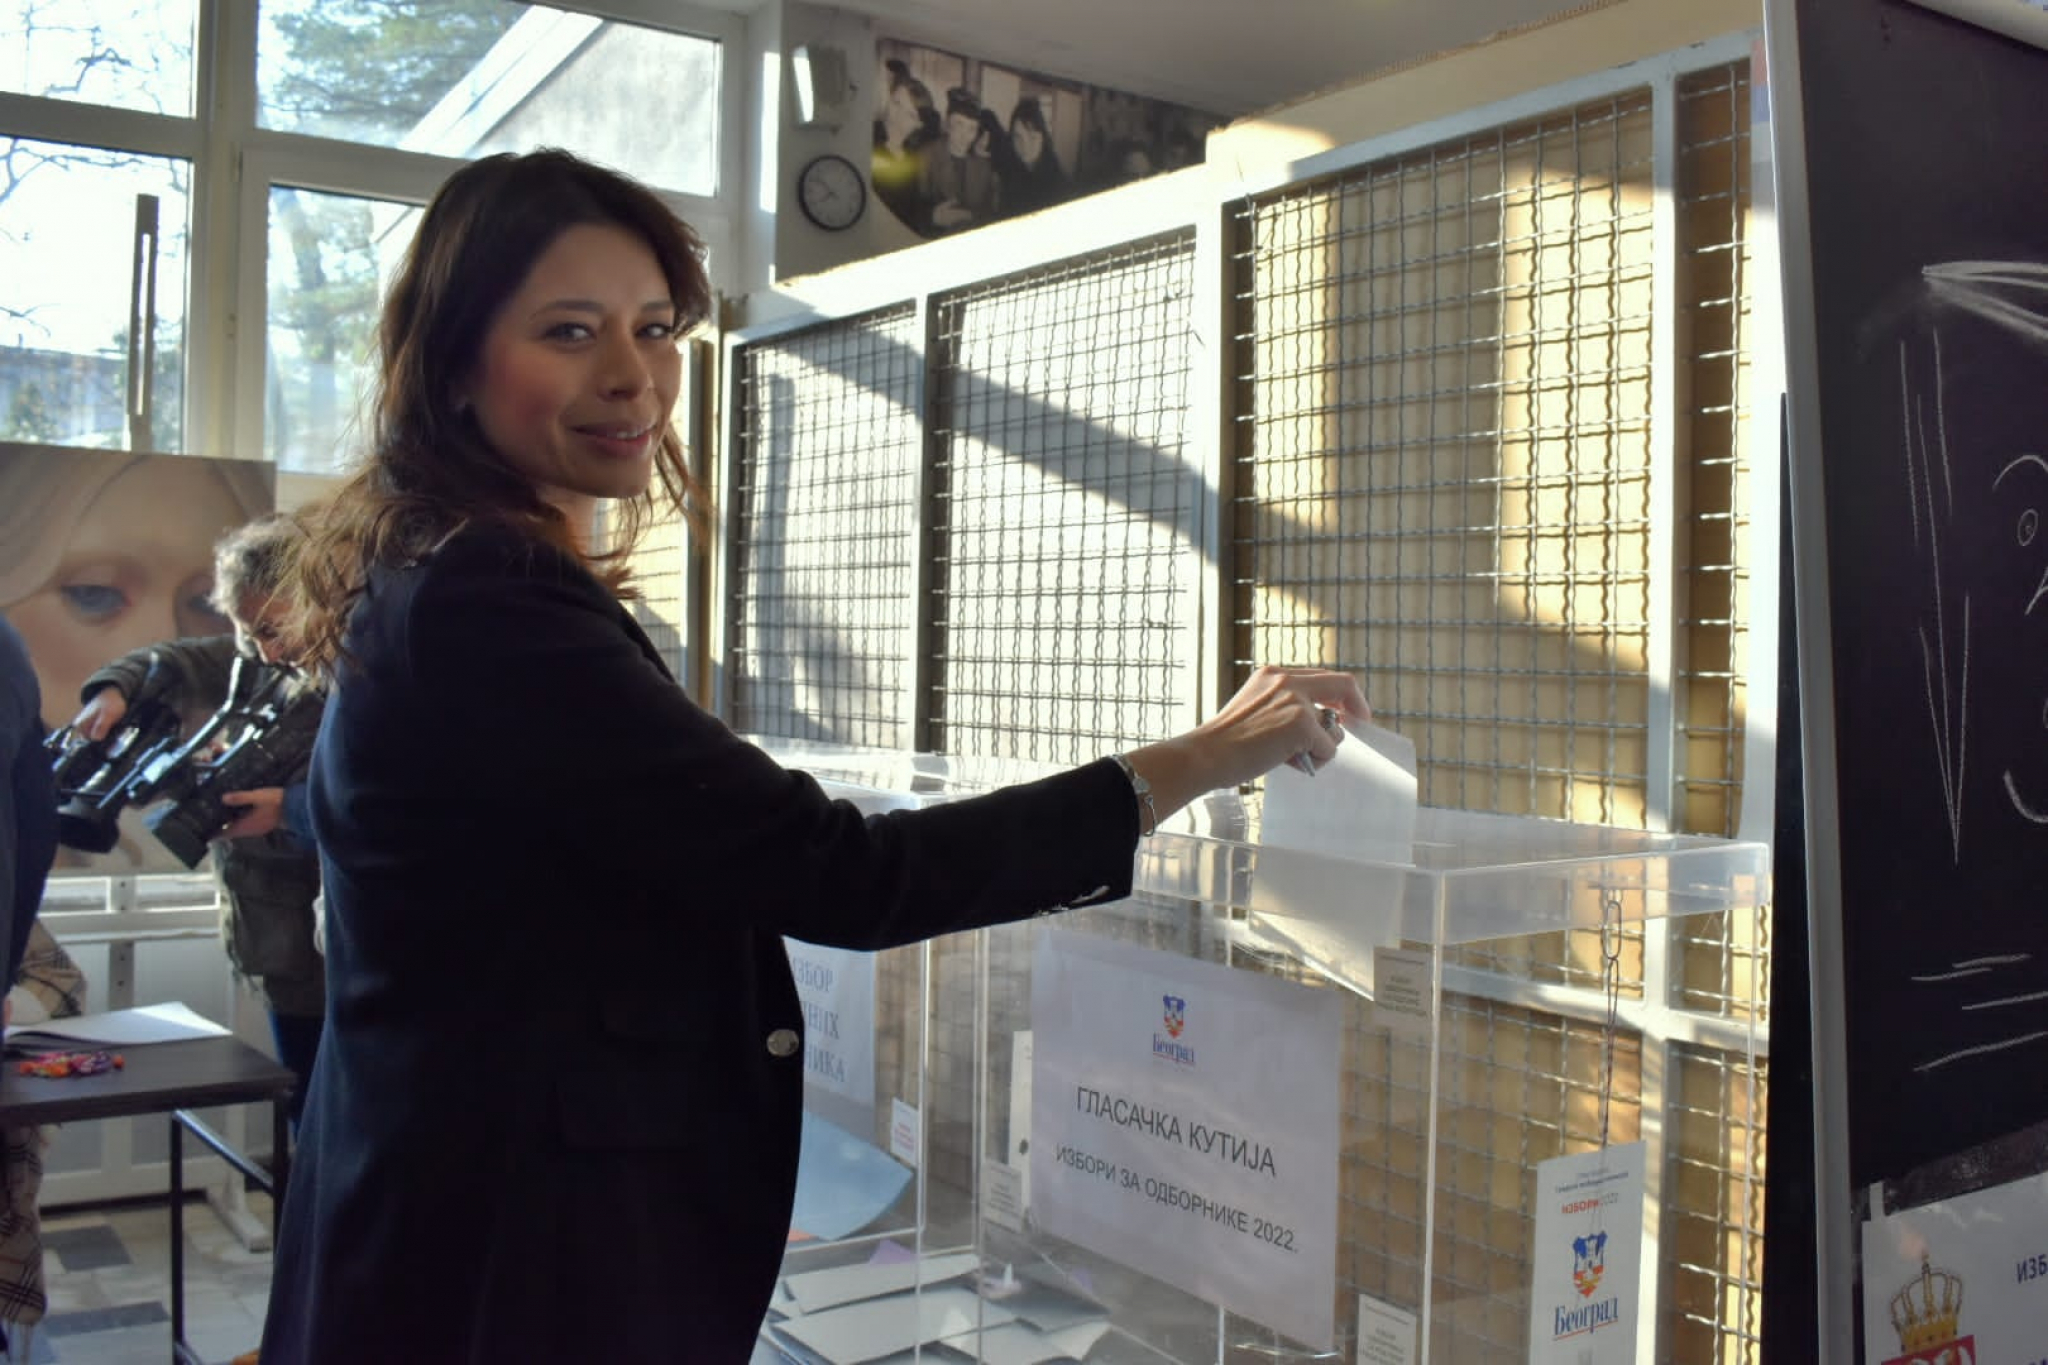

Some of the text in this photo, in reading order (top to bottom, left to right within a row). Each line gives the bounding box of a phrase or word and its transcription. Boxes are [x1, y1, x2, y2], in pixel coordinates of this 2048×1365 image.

[1077, 1087, 1276, 1177] ГЛАСАЧКА КУТИЈА
[1055, 1146, 1116, 1181] ИЗБОРИ
[1120, 1168, 1140, 1193] ЗА
[1145, 1178, 1248, 1232] ОДБОРНИКЕ
[1253, 1218, 1298, 1253] 2022.
[1555, 1297, 1619, 1335] Београд
